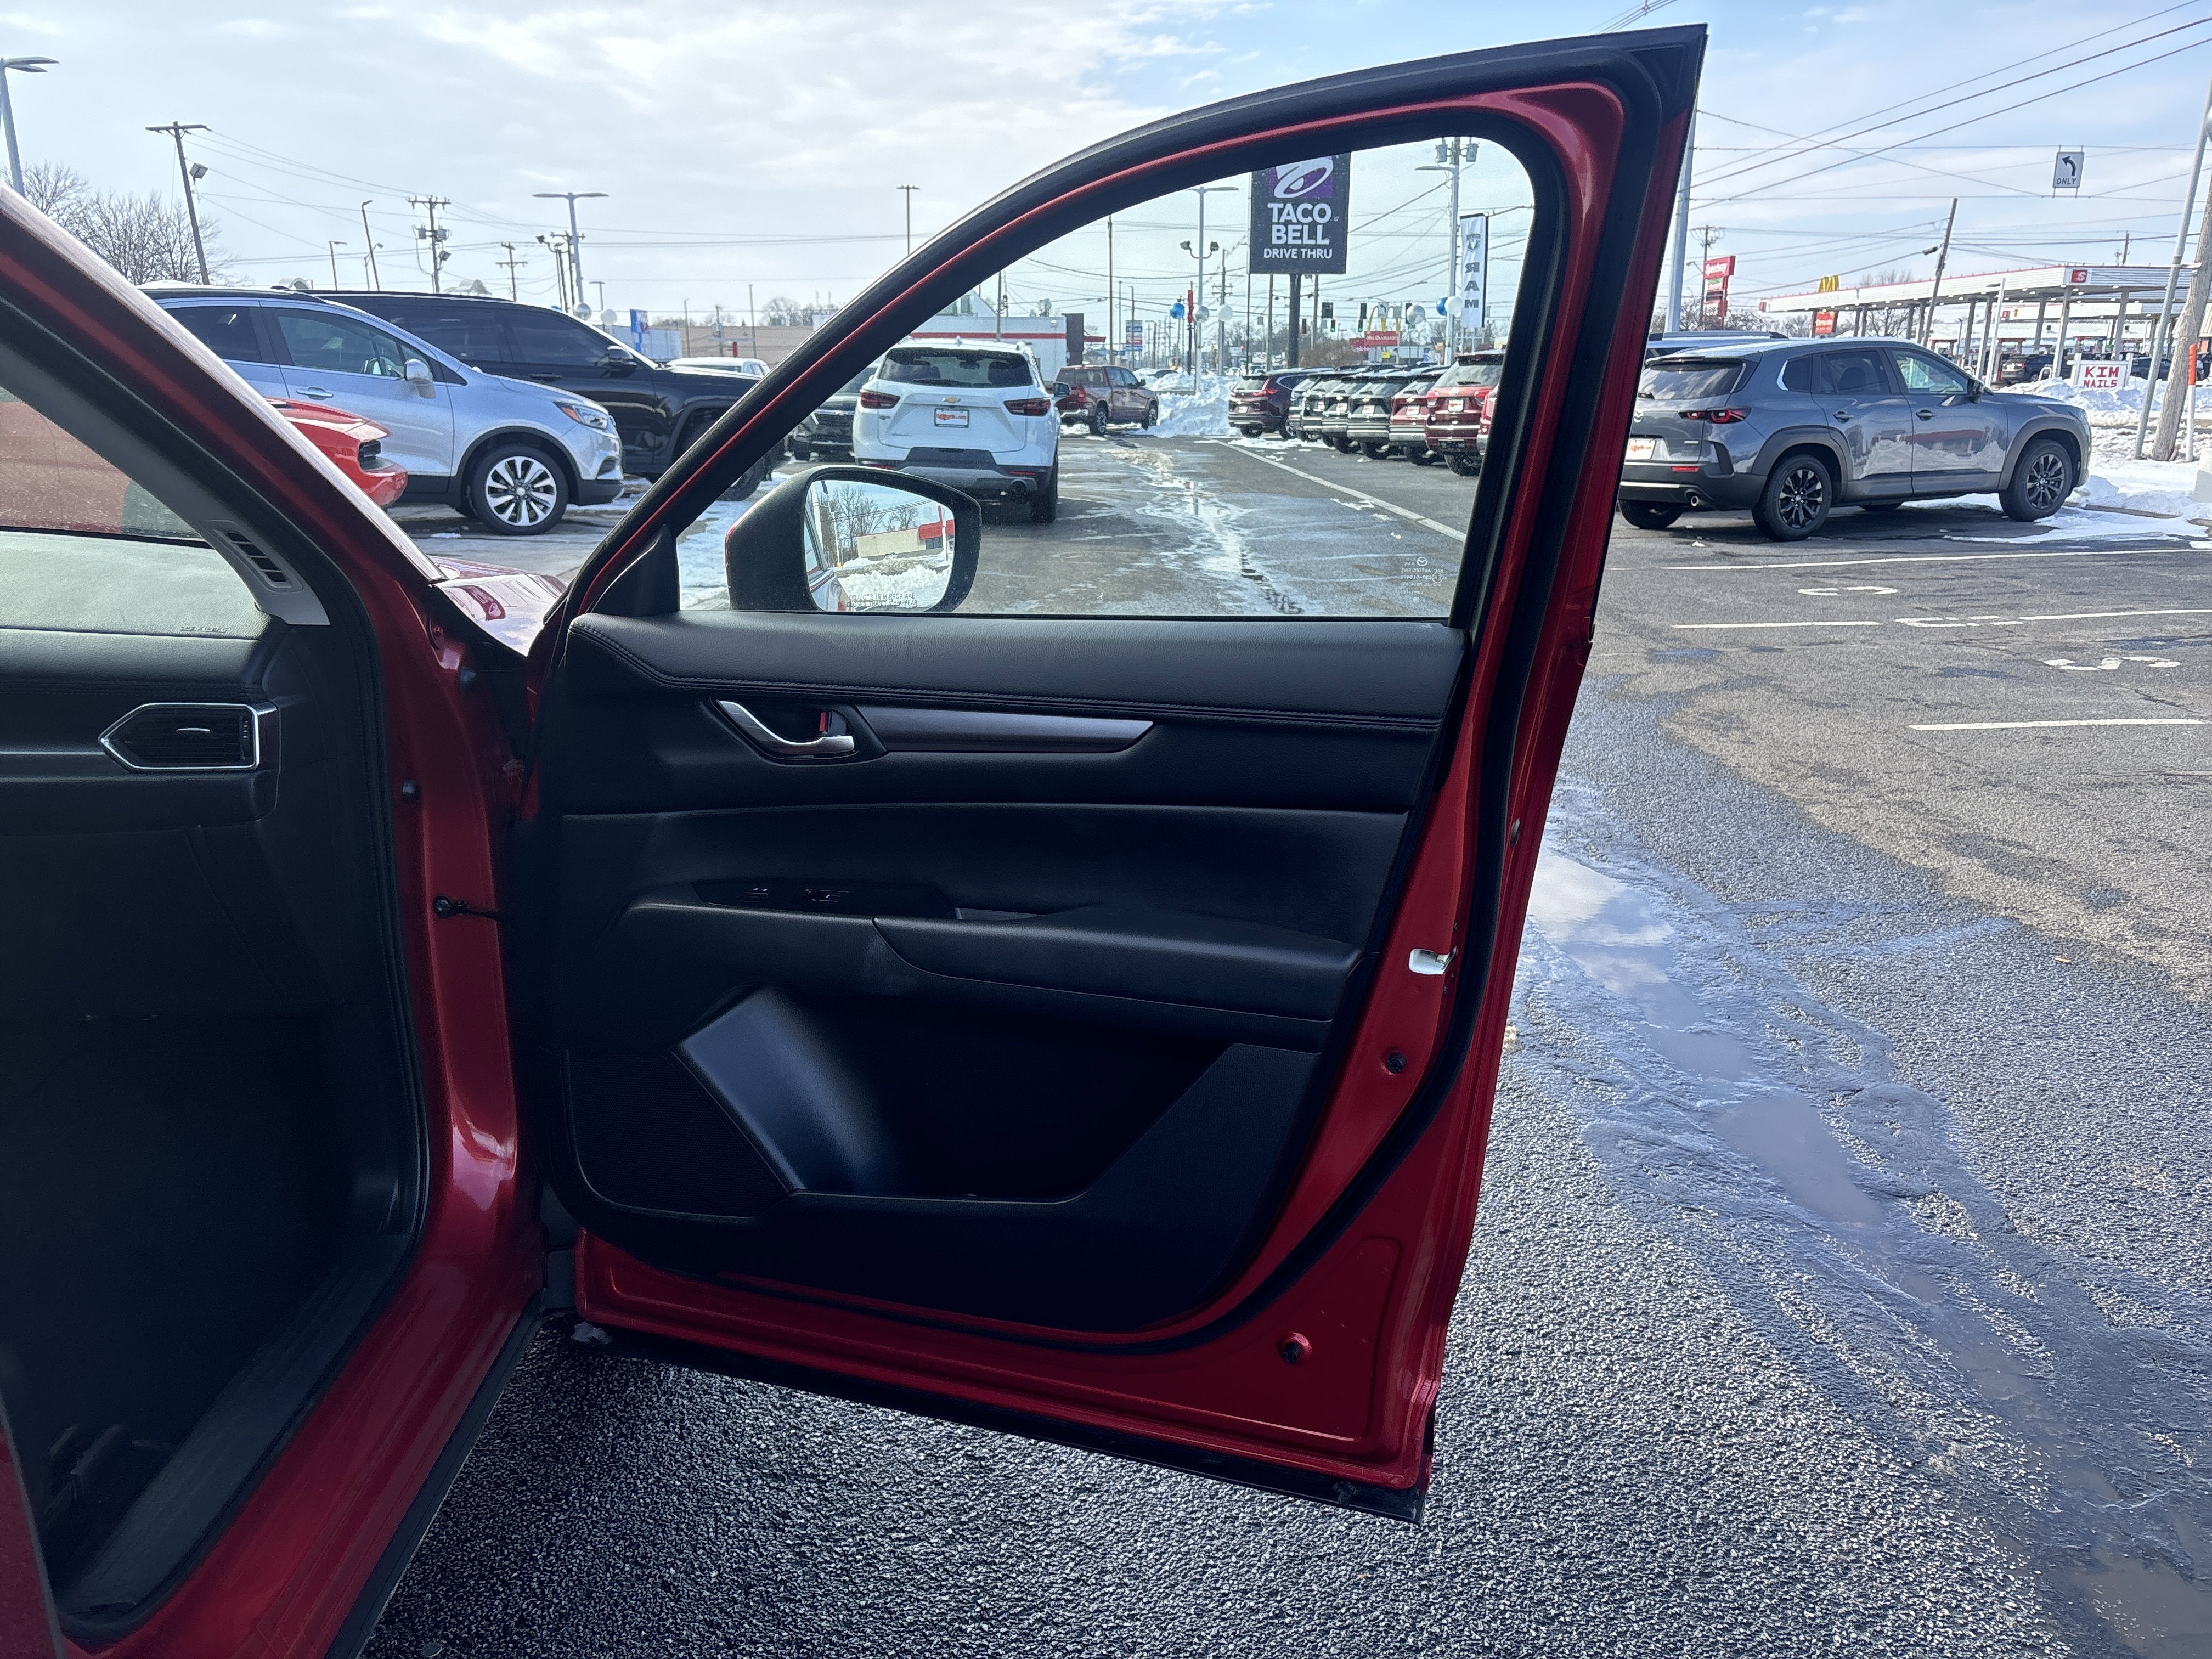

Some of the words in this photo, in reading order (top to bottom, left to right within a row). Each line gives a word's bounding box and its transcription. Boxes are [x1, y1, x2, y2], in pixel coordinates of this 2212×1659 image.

[1267, 202, 1332, 223] TACO
[1271, 224, 1330, 245] BELL
[1263, 248, 1298, 259] DRIVE
[1300, 248, 1333, 259] THRU
[2084, 366, 2120, 378] KIM
[2083, 379, 2118, 388] NAILS
